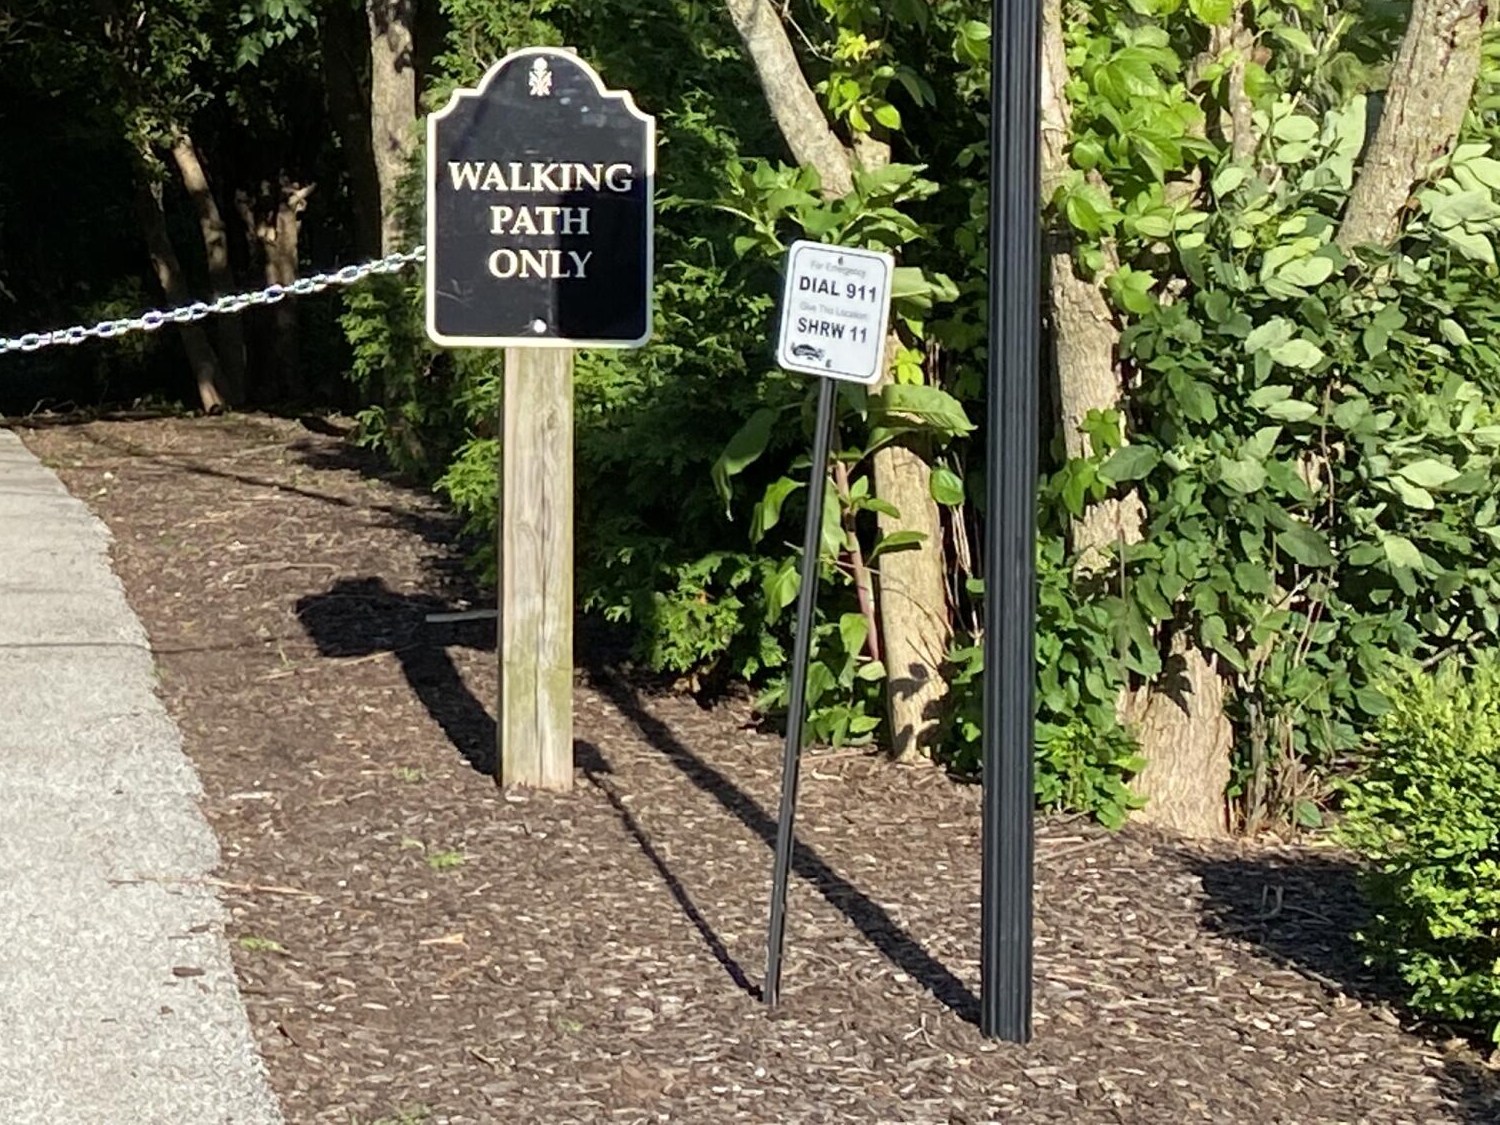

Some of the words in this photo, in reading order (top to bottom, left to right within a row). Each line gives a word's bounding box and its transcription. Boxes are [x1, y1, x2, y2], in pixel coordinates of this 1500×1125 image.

[447, 161, 633, 192] WALKING
[489, 206, 591, 235] PATH
[488, 249, 593, 279] ONLY
[799, 276, 840, 296] DIAL
[846, 283, 877, 303] 911
[797, 316, 846, 339] SHRW
[850, 326, 867, 343] 11
